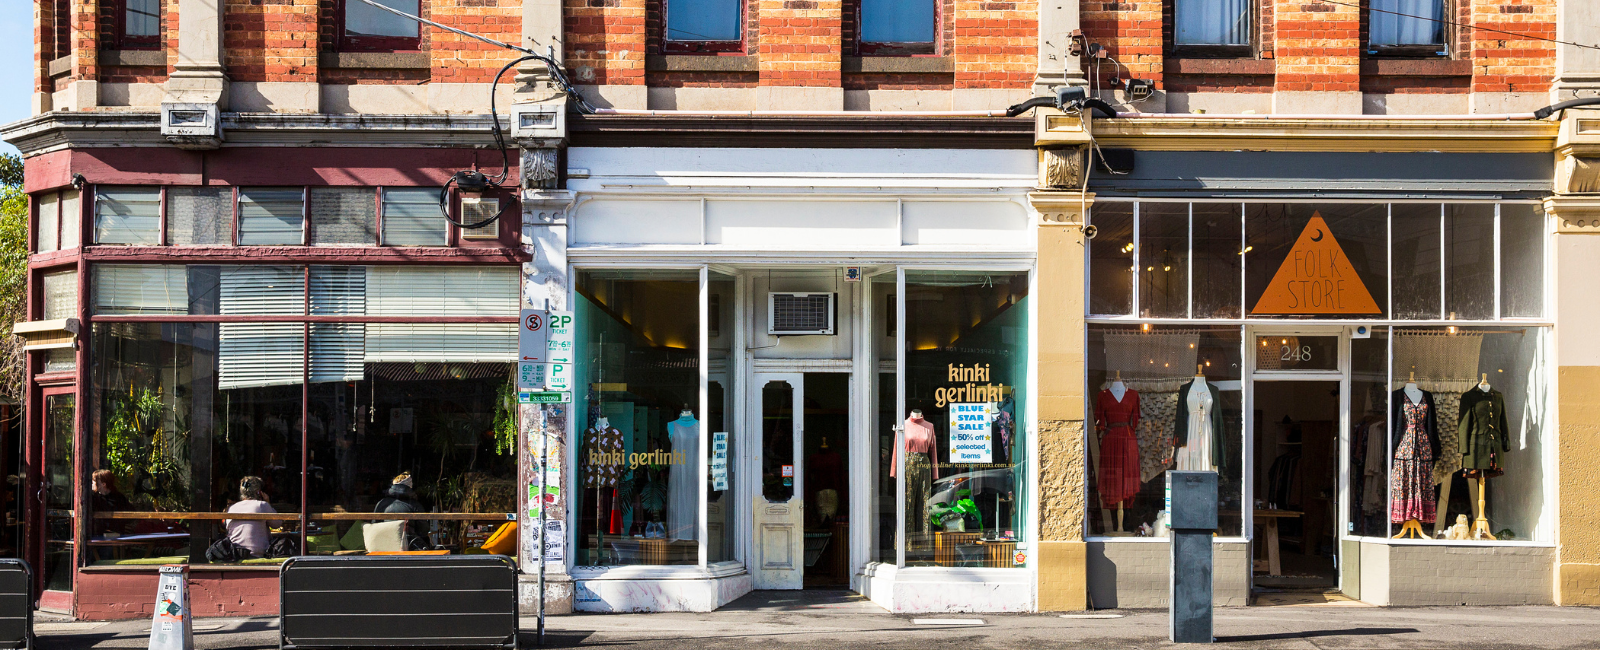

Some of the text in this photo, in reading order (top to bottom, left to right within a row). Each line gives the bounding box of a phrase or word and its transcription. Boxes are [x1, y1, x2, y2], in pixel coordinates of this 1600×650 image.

[1294, 249, 1342, 278] FOLK
[1287, 279, 1345, 309] STORE
[549, 315, 572, 328] 2P
[1280, 345, 1312, 361] 248
[552, 364, 563, 376] P
[948, 362, 990, 382] kinki
[935, 383, 1003, 408] gerlinki
[957, 423, 985, 431] SALE
[957, 433, 985, 441] 50% off
[588, 449, 687, 470] kinki gerlinki
